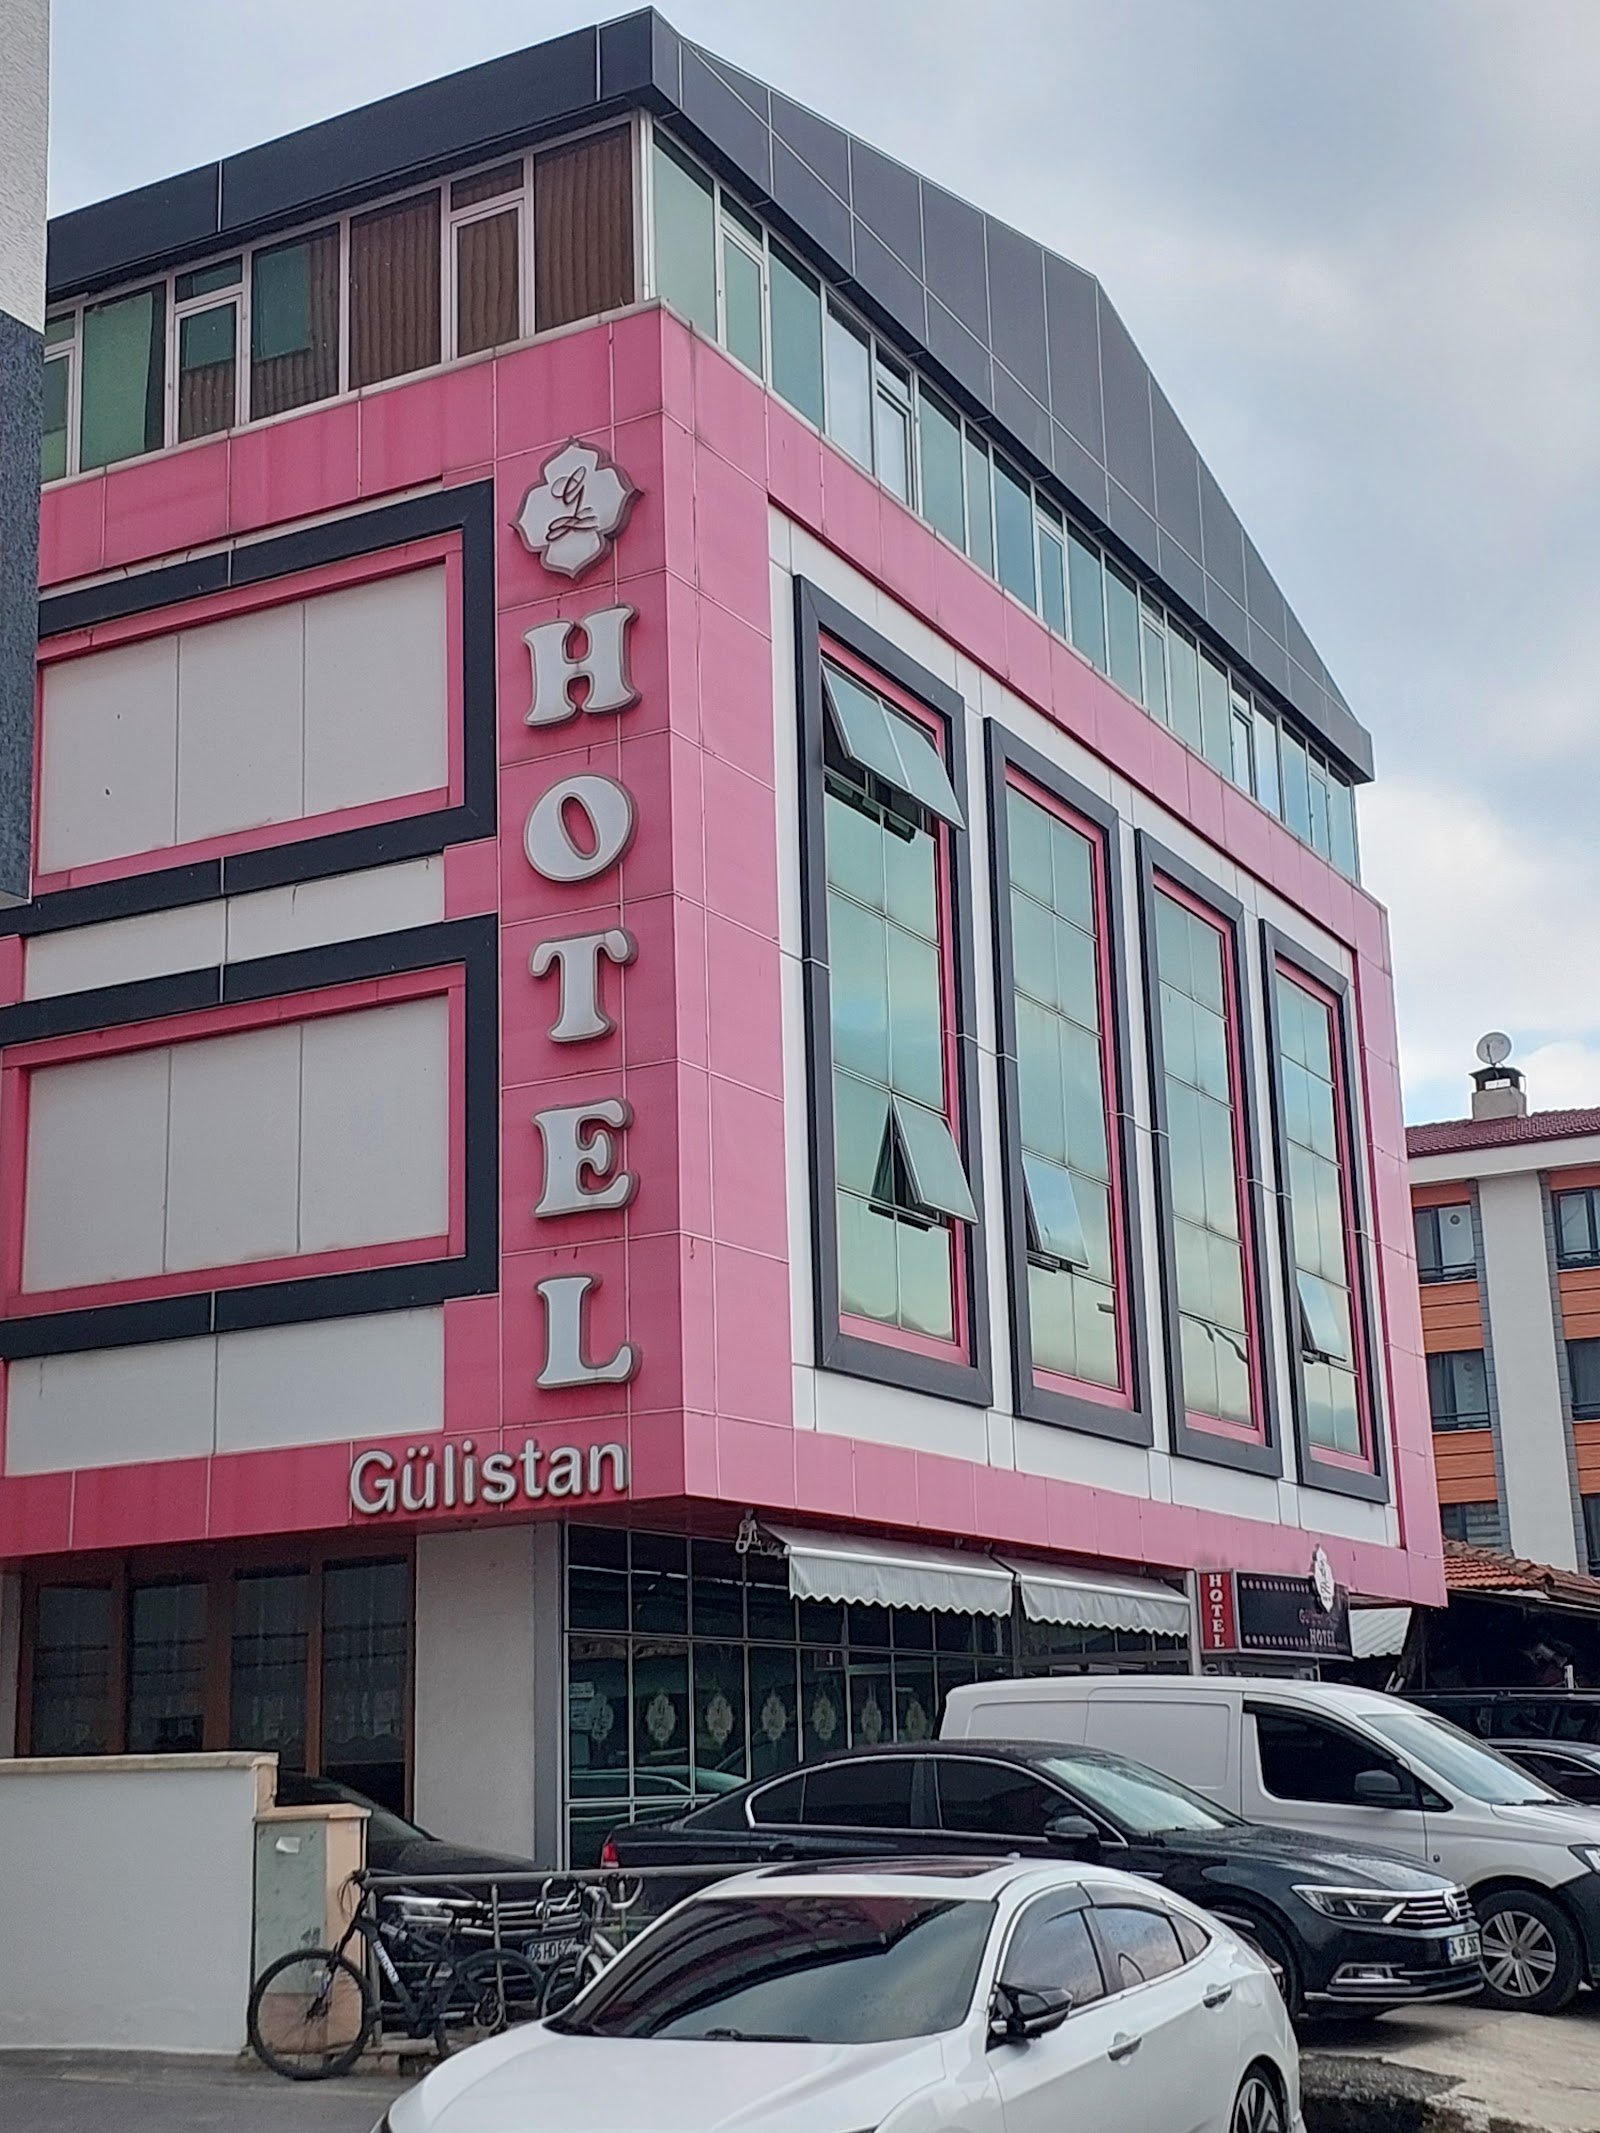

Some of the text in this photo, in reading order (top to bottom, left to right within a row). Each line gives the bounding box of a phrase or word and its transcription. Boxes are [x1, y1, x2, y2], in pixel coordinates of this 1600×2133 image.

[522, 604, 642, 1391] HOTEL
[350, 1438, 630, 1514] Gülistan
[1208, 1573, 1225, 1648] HOTEL
[1309, 1627, 1338, 1648] HOTEL
